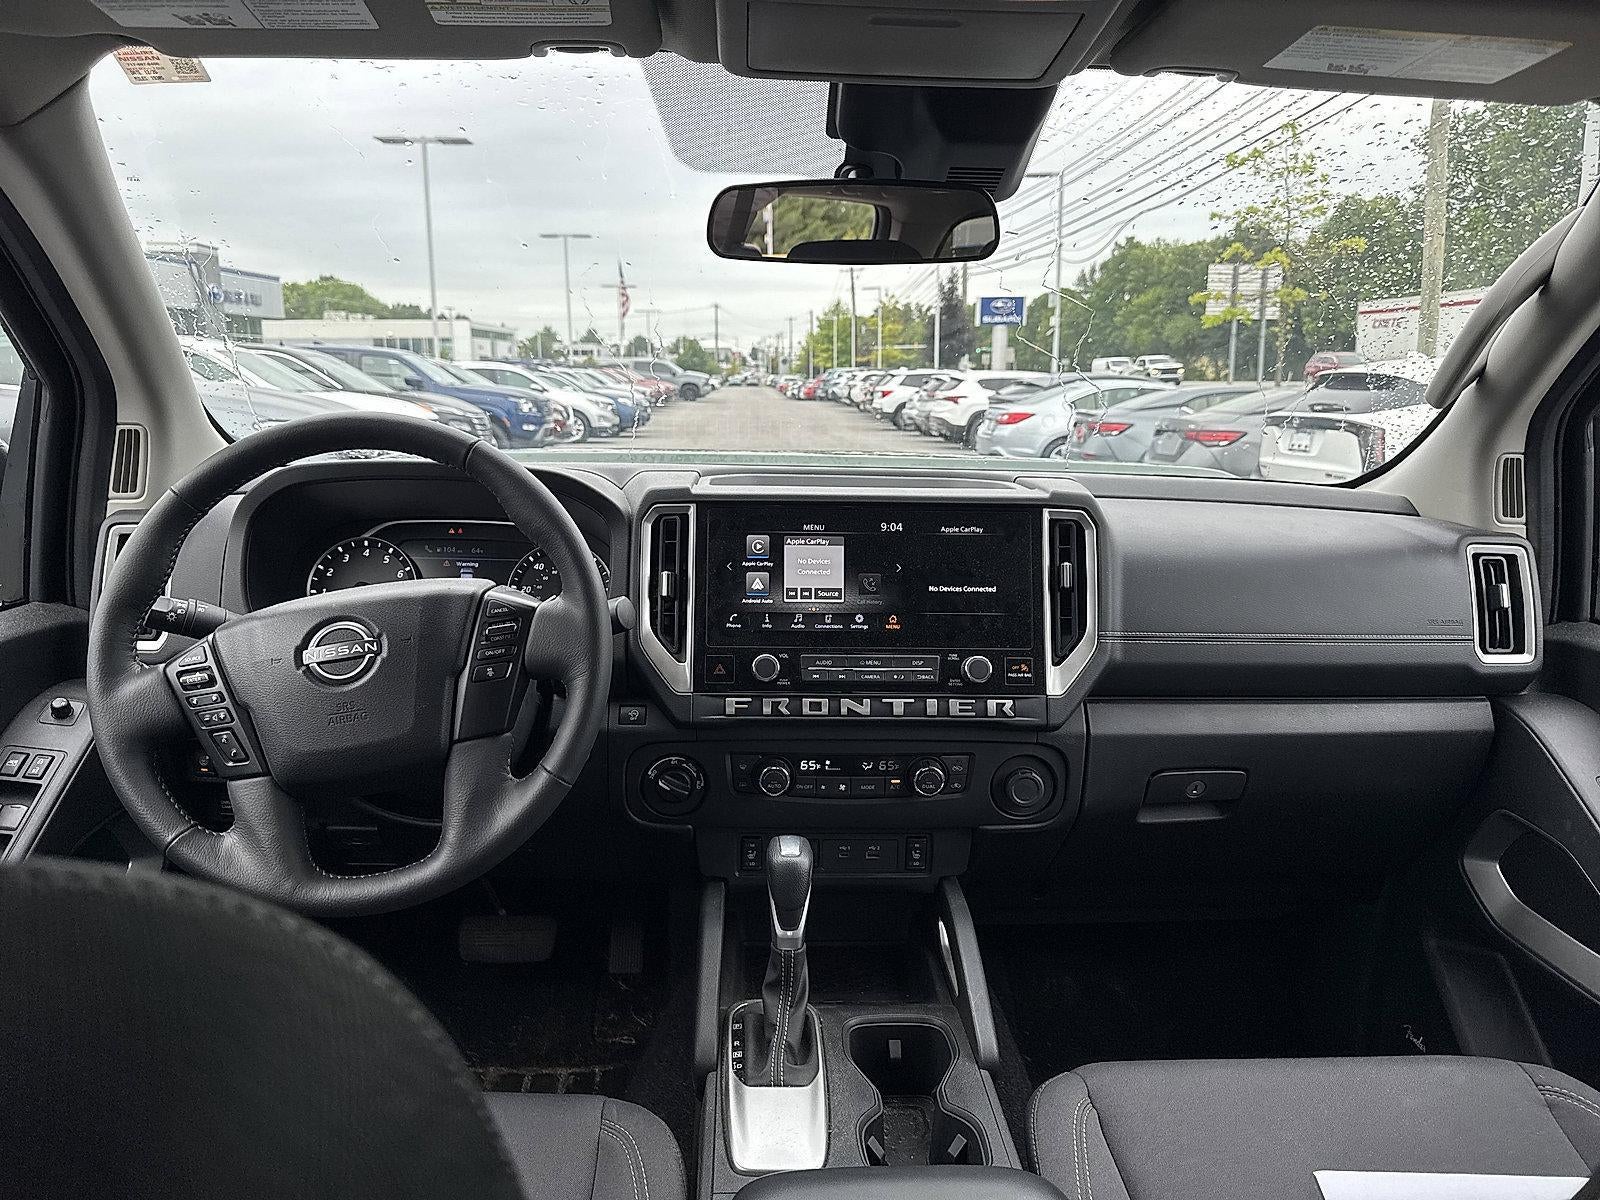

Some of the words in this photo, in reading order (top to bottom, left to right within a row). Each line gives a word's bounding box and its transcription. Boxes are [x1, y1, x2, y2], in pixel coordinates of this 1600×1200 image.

[880, 522, 903, 532] 9:04
[362, 548, 370, 556] 4
[342, 554, 350, 562] 3
[383, 555, 390, 564] 5
[326, 568, 334, 577] 2
[397, 570, 404, 578] 6
[306, 642, 378, 660] NISSAN
[336, 700, 356, 712] SRS
[726, 698, 1014, 716] FRONTIER
[328, 712, 368, 726] AIRBAG
